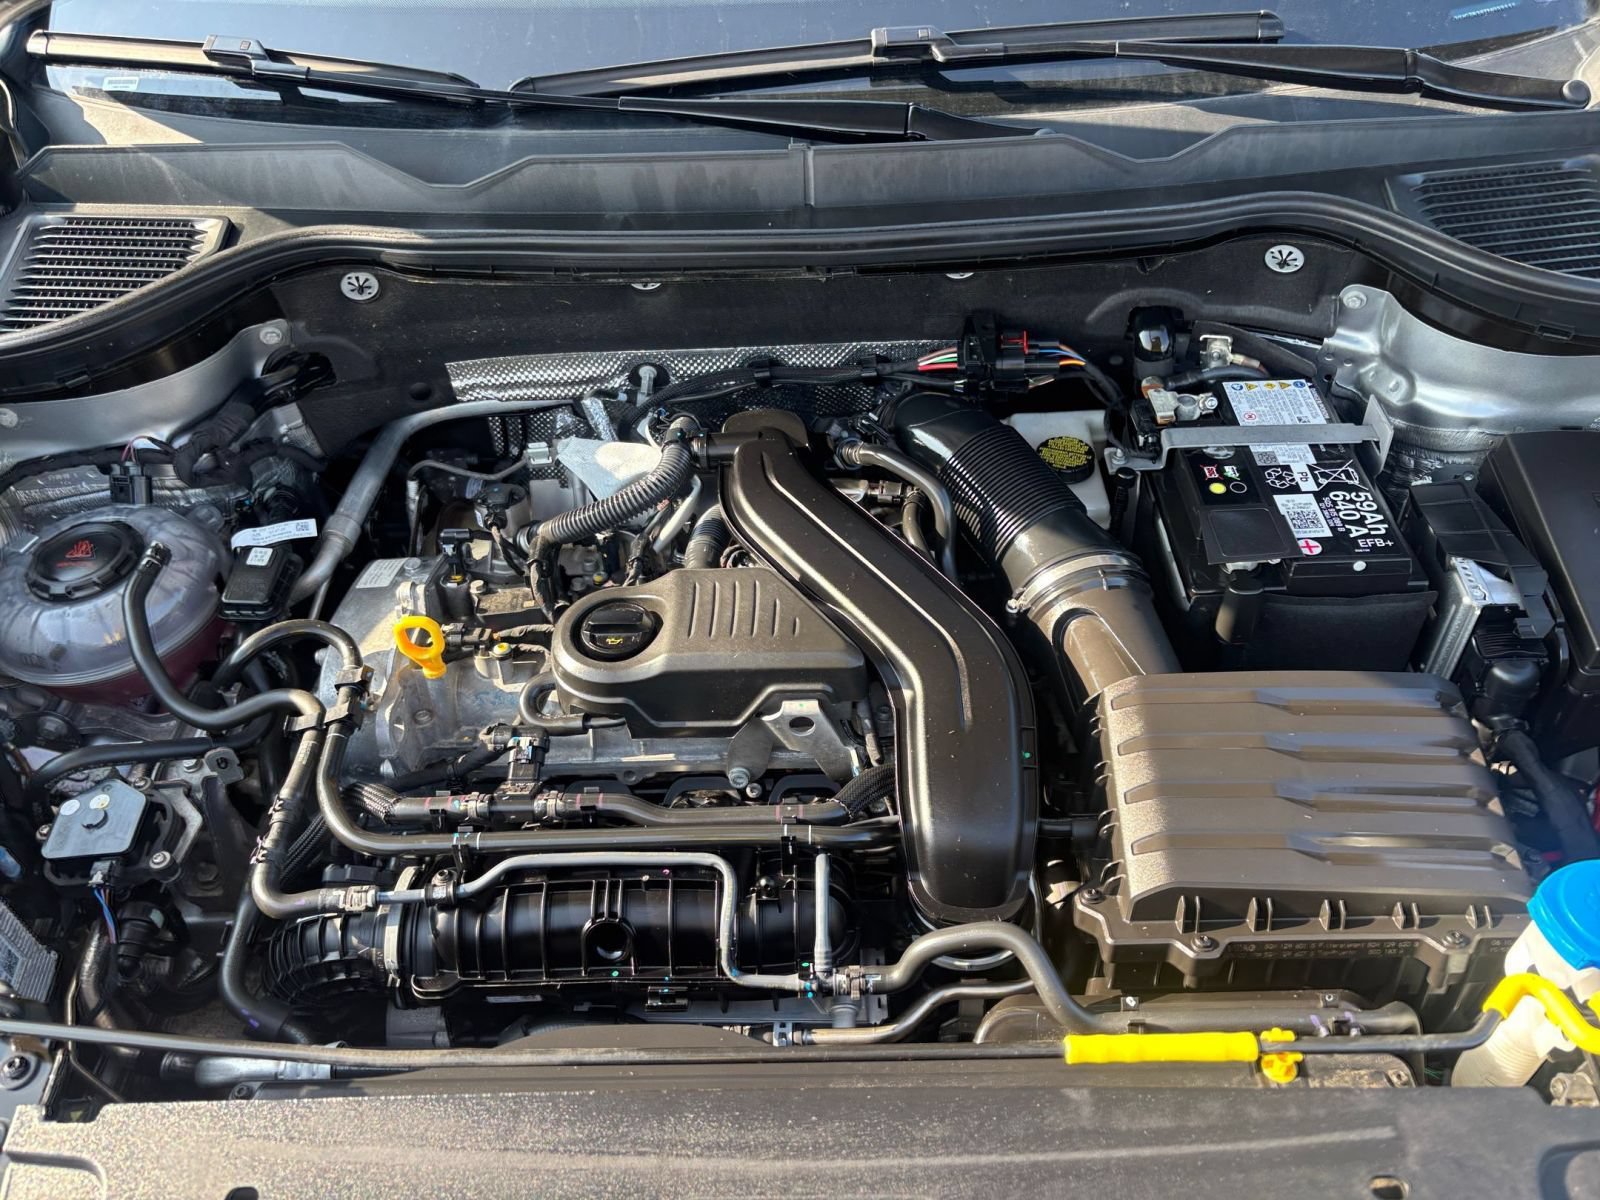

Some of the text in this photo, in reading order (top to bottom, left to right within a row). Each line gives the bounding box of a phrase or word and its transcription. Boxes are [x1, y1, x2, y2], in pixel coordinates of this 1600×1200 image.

[1297, 472, 1310, 482] Pb
[1329, 490, 1361, 520] 640
[1345, 524, 1370, 538] A
[1350, 492, 1388, 534] 59Ah
[1357, 538, 1394, 548] EFB+
